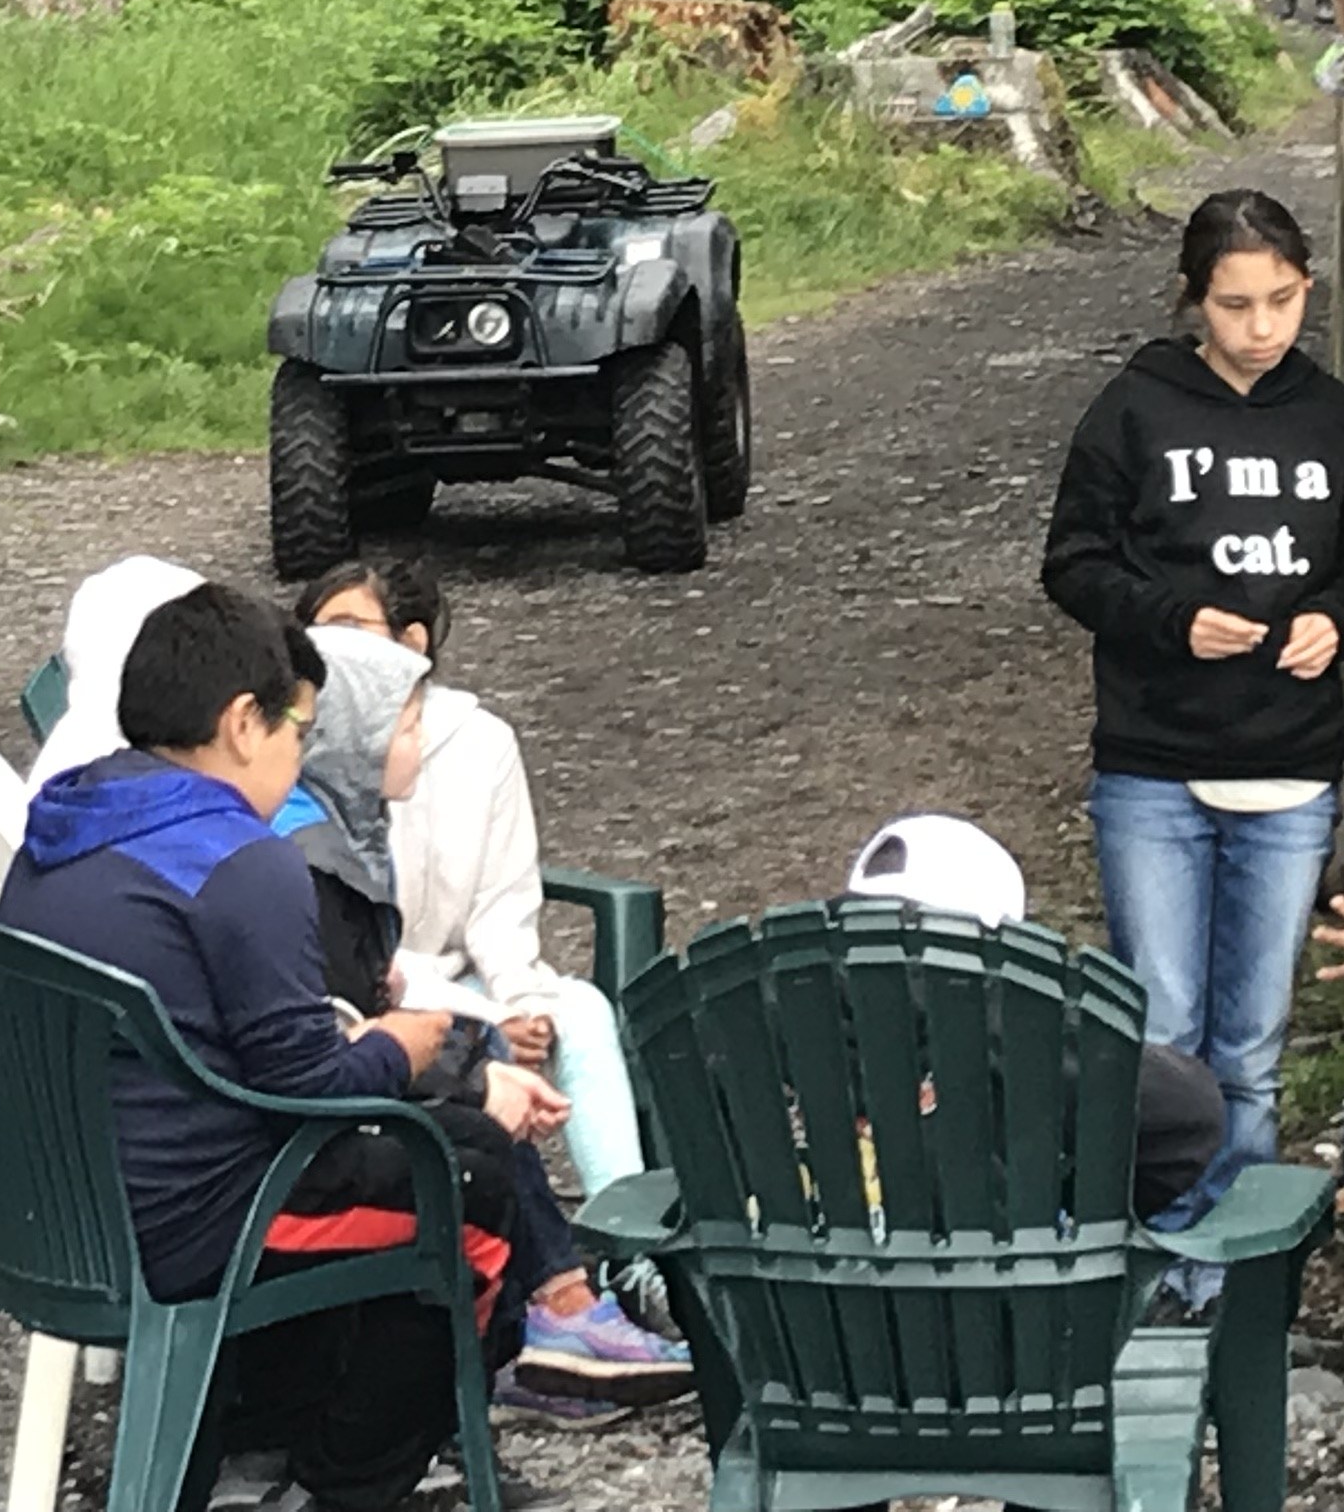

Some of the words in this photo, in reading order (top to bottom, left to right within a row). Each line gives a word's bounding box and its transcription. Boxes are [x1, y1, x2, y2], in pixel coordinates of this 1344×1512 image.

[1163, 445, 1281, 503] I'm
[1292, 459, 1331, 501] a
[1210, 524, 1311, 576] cat.
